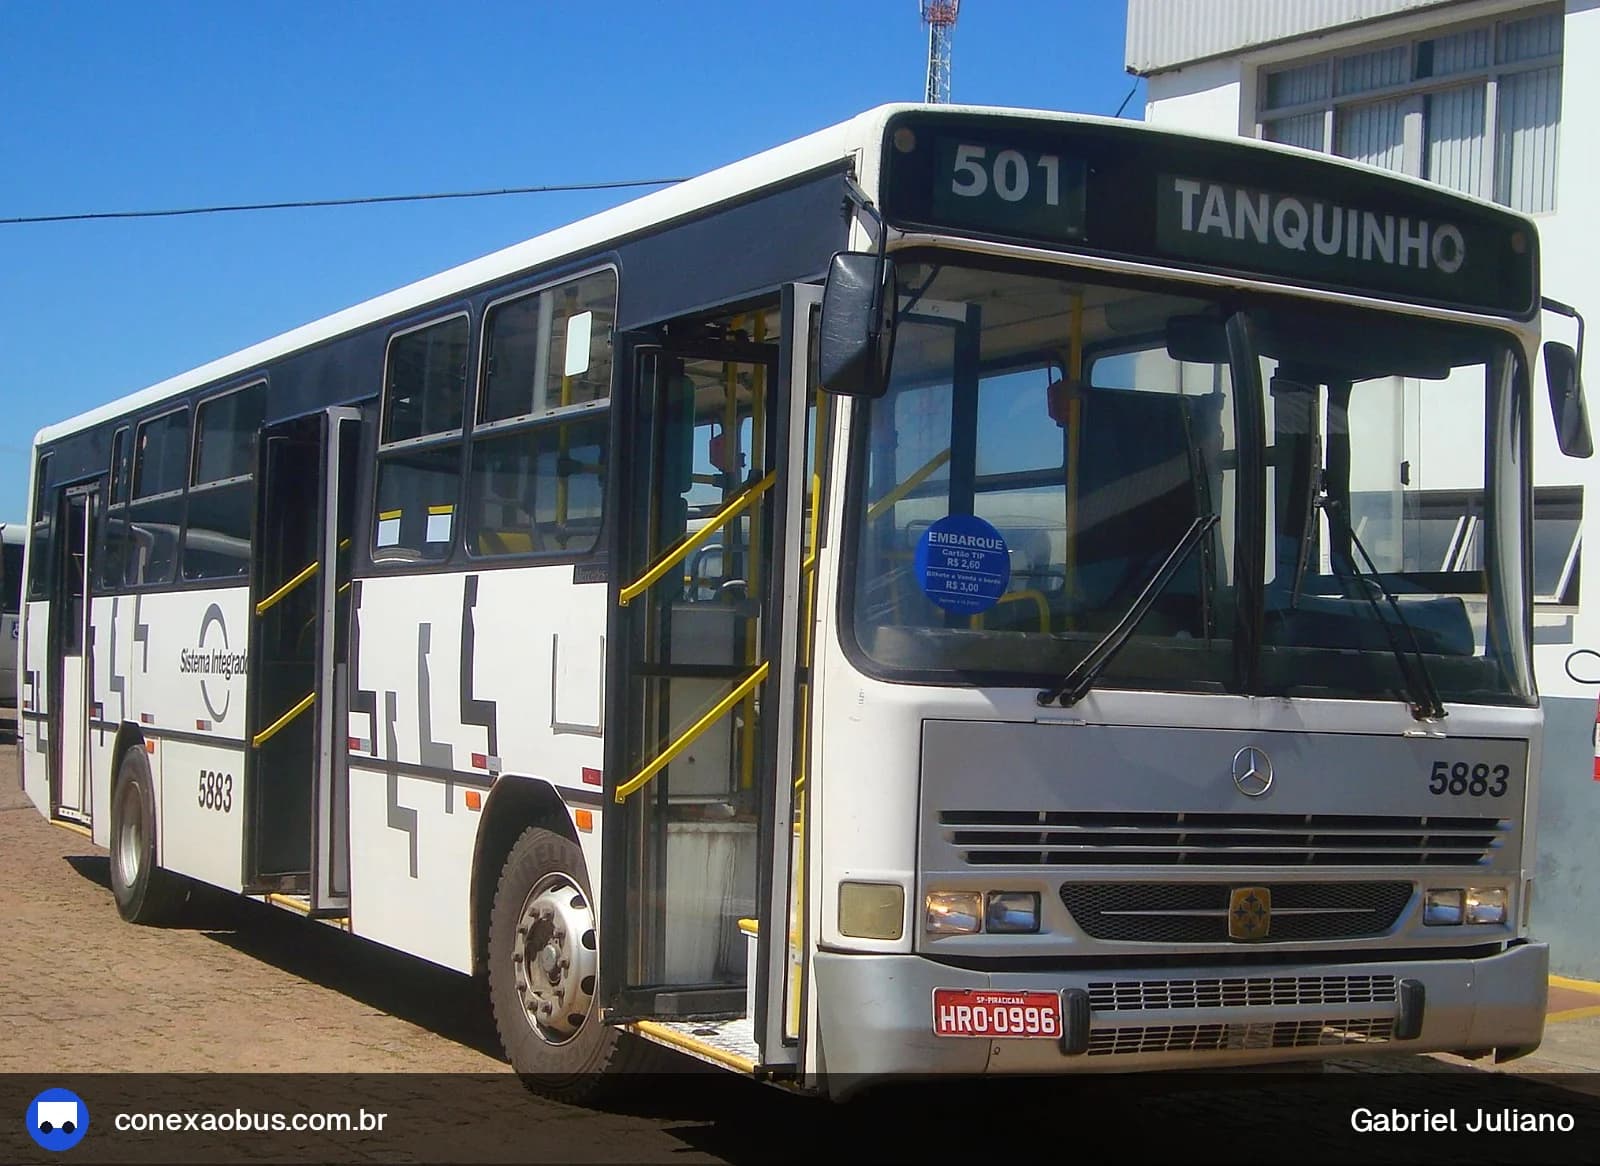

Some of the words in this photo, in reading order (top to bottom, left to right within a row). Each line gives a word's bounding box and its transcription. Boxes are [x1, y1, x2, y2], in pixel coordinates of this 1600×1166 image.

[952, 144, 1059, 206] 501
[1175, 178, 1466, 274] TANQUINHO
[928, 531, 1004, 550] EMBARQUE
[942, 548, 970, 558] Cartão
[947, 557, 959, 568] R$
[961, 559, 981, 569] 2,60
[946, 580, 958, 590] R$
[960, 582, 979, 592] 3,00
[180, 648, 210, 673] Sistema
[198, 769, 233, 813] 5883
[1429, 761, 1510, 797] 5883
